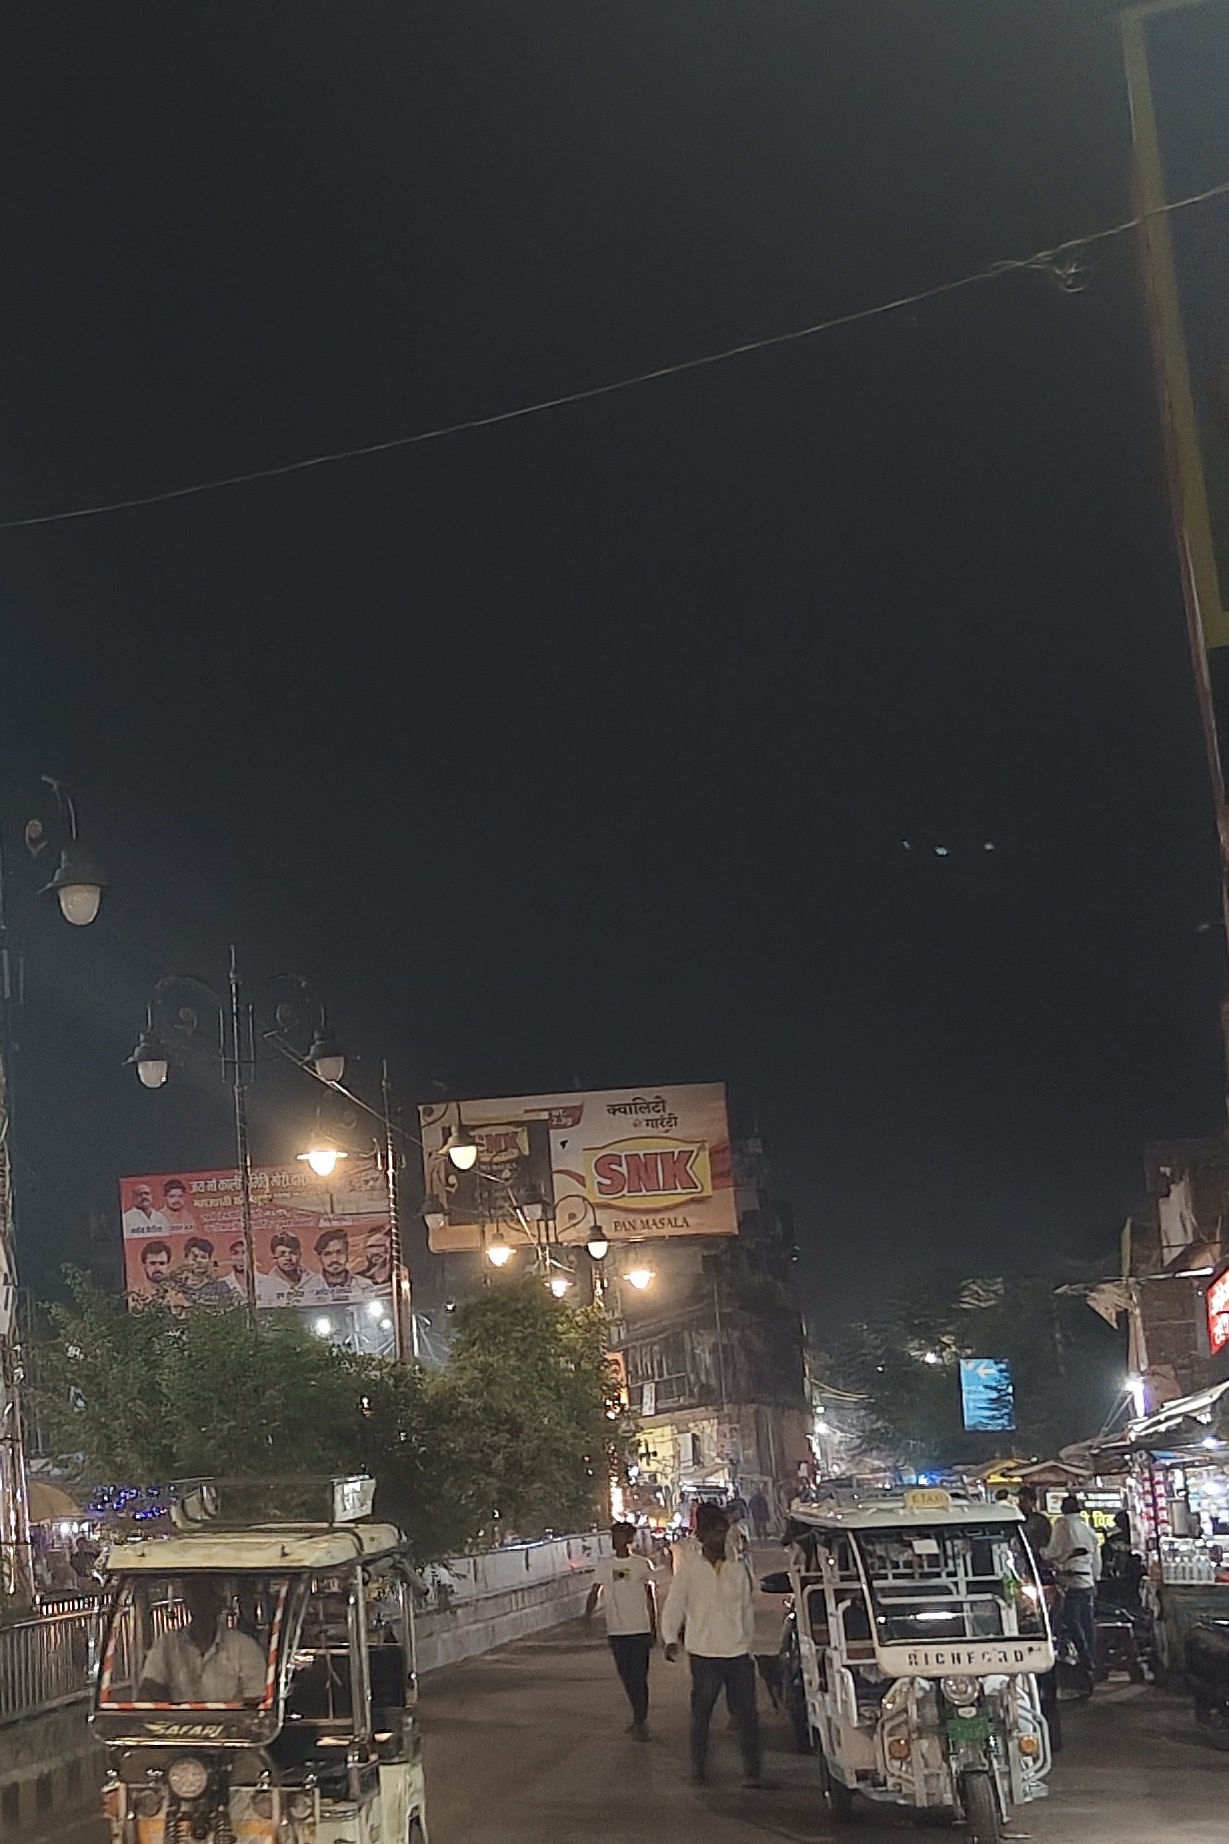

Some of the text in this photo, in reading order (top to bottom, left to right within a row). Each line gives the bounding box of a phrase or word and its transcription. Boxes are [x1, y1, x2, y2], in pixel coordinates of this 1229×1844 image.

[592, 1148, 703, 1198] SNK
[612, 1216, 691, 1232] PAN MASALA
[144, 1720, 225, 1738] SAFARI
